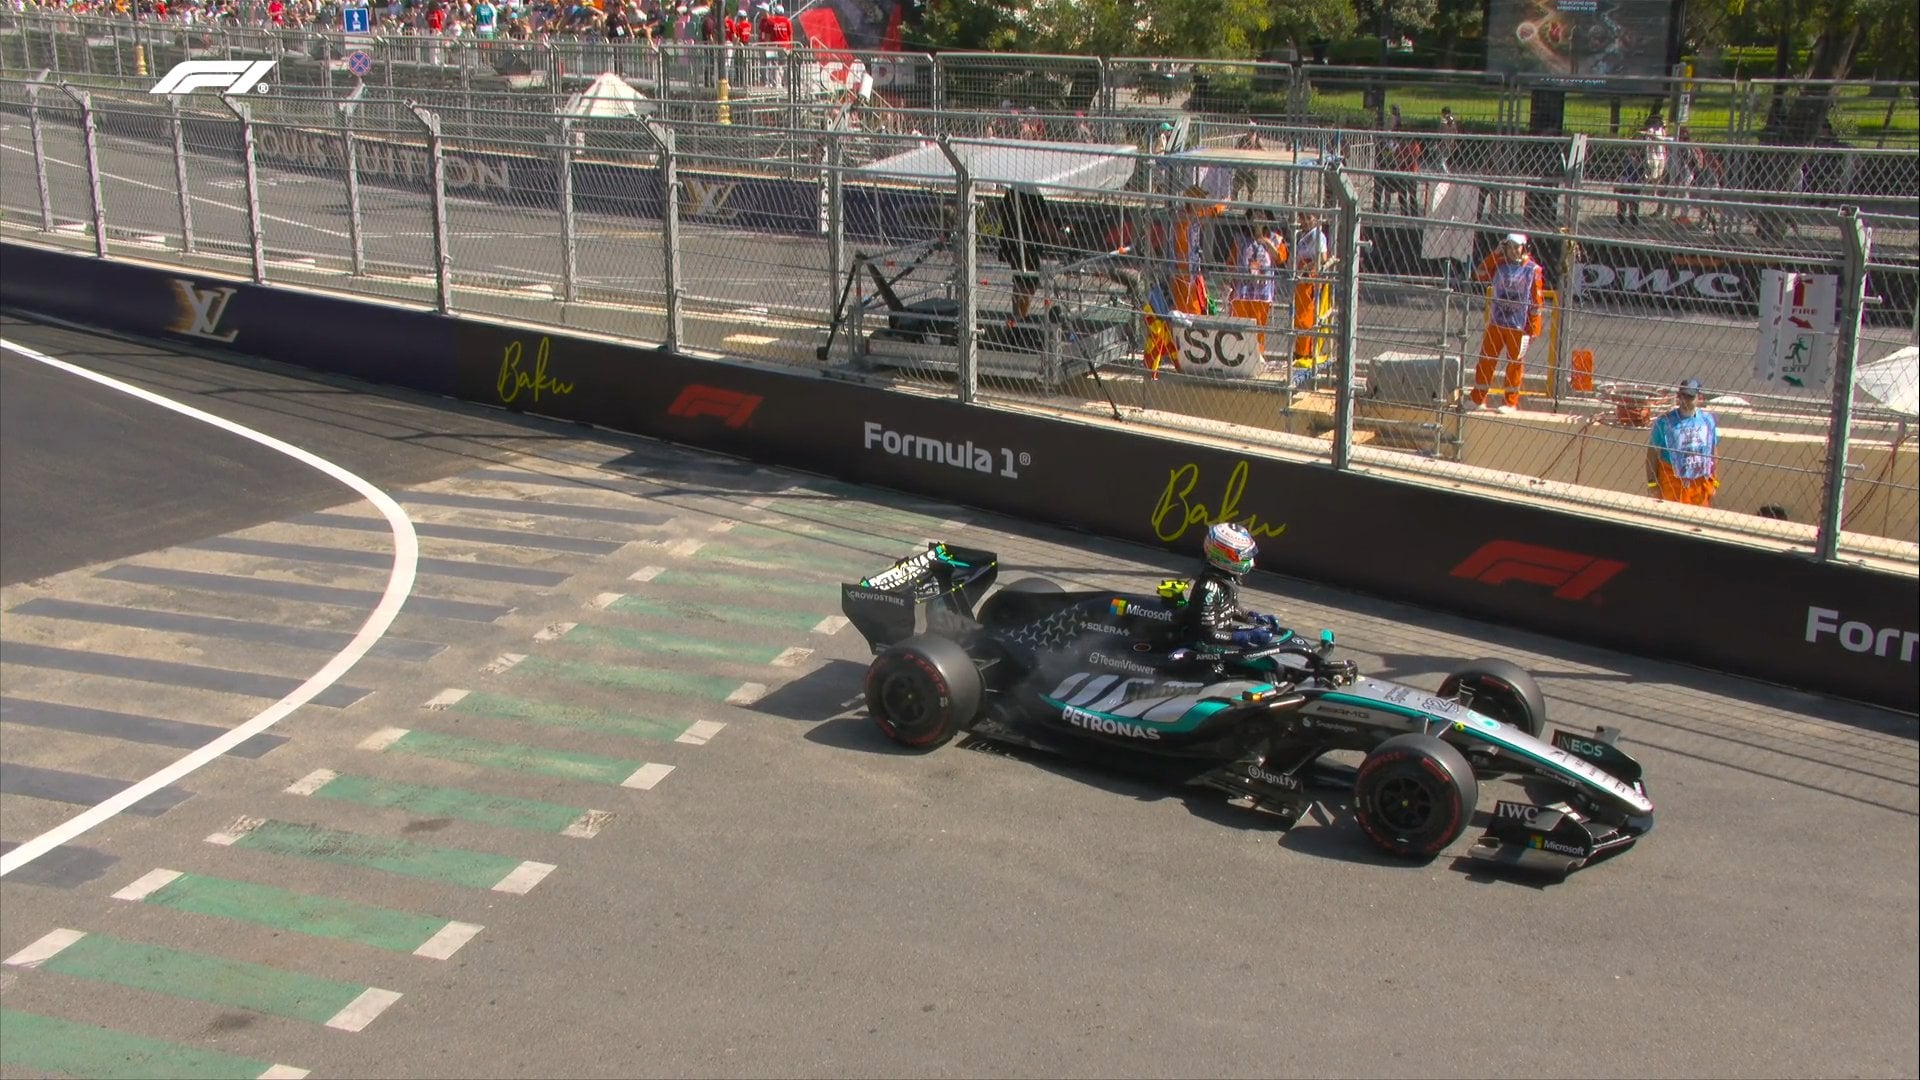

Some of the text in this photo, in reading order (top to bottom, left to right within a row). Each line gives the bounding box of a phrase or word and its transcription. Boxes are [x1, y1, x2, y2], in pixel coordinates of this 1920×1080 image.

[256, 127, 328, 168] OUIS
[1183, 326, 1245, 367] SC
[497, 336, 574, 402] Baku
[864, 421, 992, 474] Formula
[1152, 460, 1286, 542] Baku
[850, 591, 905, 606] CROWDSTRIKE
[1126, 604, 1173, 622] Microsoft
[1086, 622, 1125, 636] SOLERA
[1100, 654, 1156, 675] TeamViewer
[1062, 705, 1161, 740] PETRONAS
[1557, 734, 1603, 757] INEOS
[1498, 802, 1539, 824] IWC
[1544, 839, 1585, 856] Microsoft
